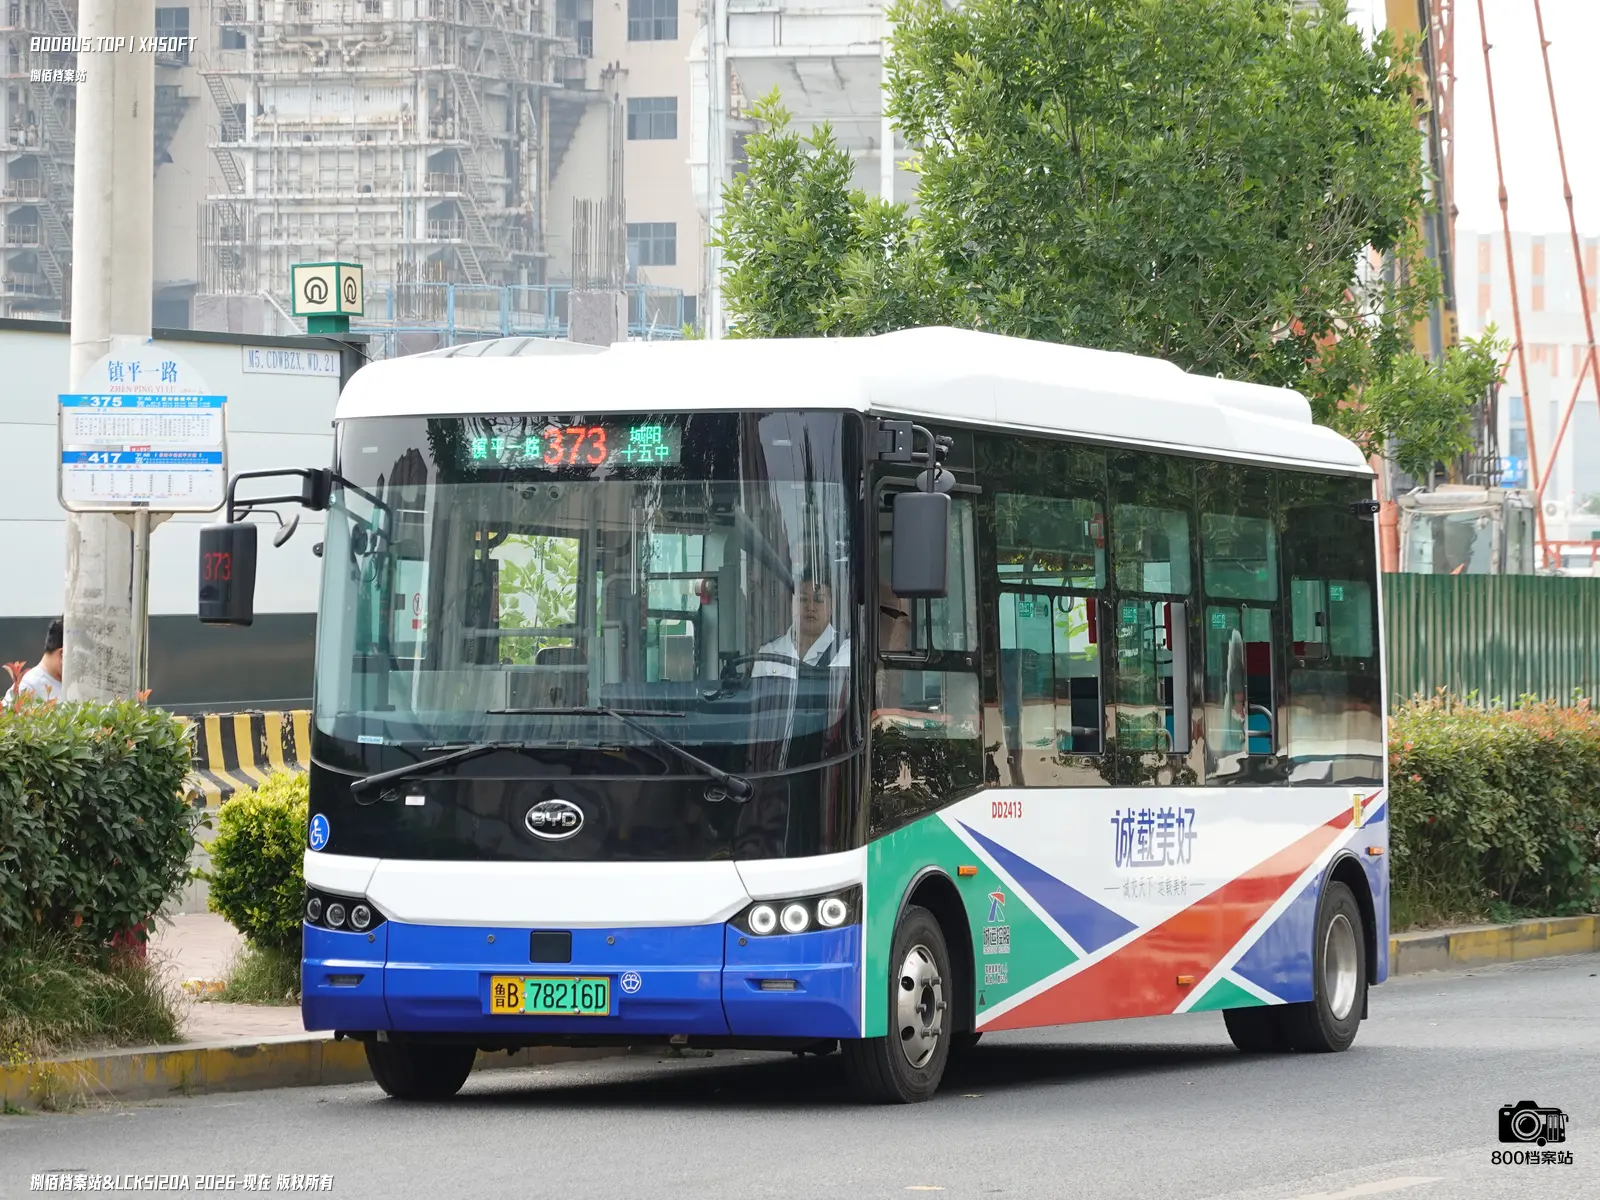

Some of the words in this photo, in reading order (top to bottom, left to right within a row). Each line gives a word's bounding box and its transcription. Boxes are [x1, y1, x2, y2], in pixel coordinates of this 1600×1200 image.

[108, 361, 178, 383] 镇平一路
[109, 385, 132, 393] ZHEN
[133, 385, 153, 393] PING
[90, 397, 123, 407] 375
[629, 426, 662, 444] 城阳
[472, 436, 540, 459] 镇平一路
[543, 426, 607, 465] 373
[621, 444, 669, 462] 十五中
[88, 453, 122, 463] 417
[203, 552, 231, 581] 373
[531, 811, 577, 827] BYD
[991, 801, 1023, 819] DD2413
[1110, 806, 1198, 868] 诚载美好
[494, 983, 519, 1008] 鲁B
[530, 983, 606, 1009] 78216D
